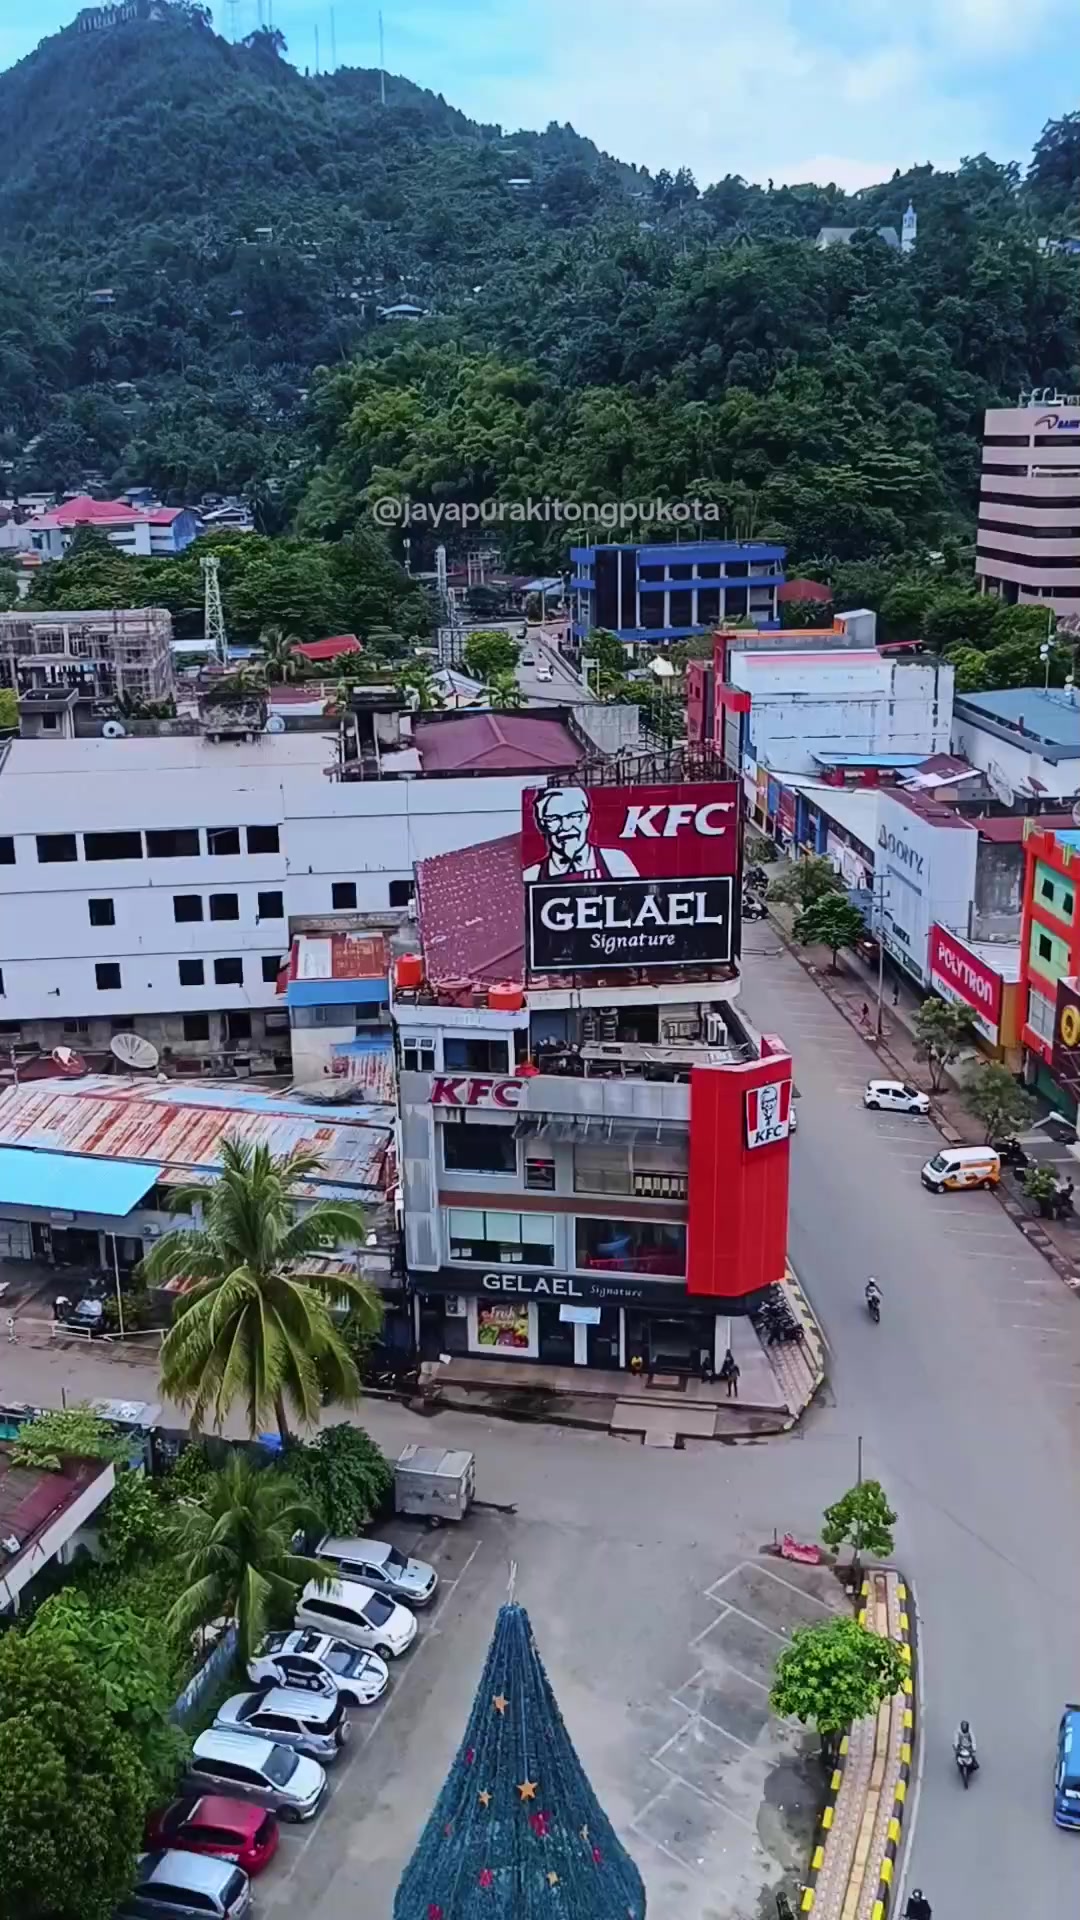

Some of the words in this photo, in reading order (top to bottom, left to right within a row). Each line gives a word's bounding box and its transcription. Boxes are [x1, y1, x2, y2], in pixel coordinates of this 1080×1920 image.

[619, 802, 731, 838] KFC
[540, 892, 723, 931] GELAEL
[590, 933, 676, 955] Signature
[938, 941, 992, 1006] POLYTRON
[432, 1077, 523, 1108] KFC
[754, 1124, 782, 1144] KFC
[482, 1273, 583, 1297] GELAEL
[589, 1284, 643, 1298] Signature
